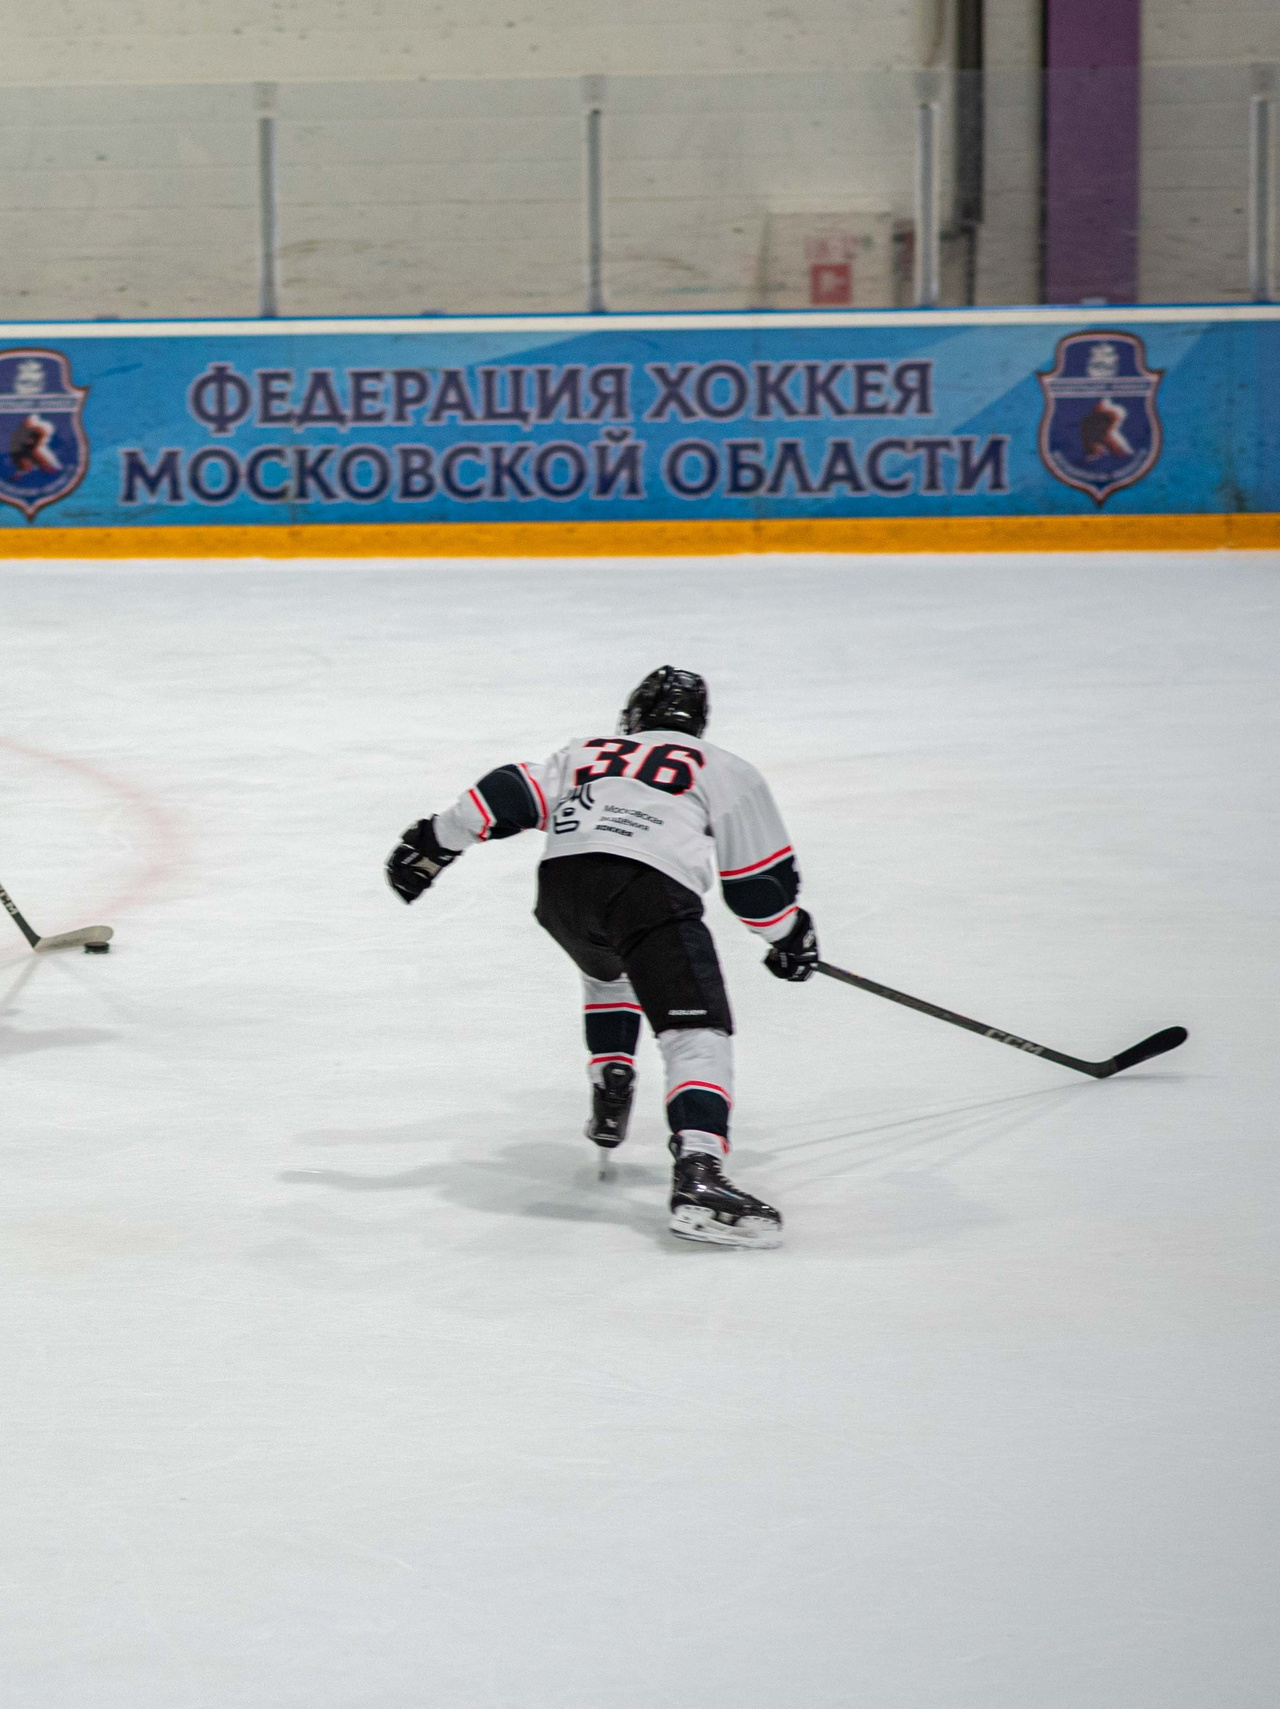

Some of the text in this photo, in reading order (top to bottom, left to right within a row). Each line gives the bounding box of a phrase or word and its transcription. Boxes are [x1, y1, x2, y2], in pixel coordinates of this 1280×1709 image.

[188, 358, 934, 436] ФЕДЕРАЦИЯ ХОККЕЯ
[122, 427, 646, 506] МОСКОВСКОЙ
[662, 433, 1010, 500] ОБЛАСТИ
[573, 738, 706, 796] 36
[984, 1027, 1046, 1056] CCM
